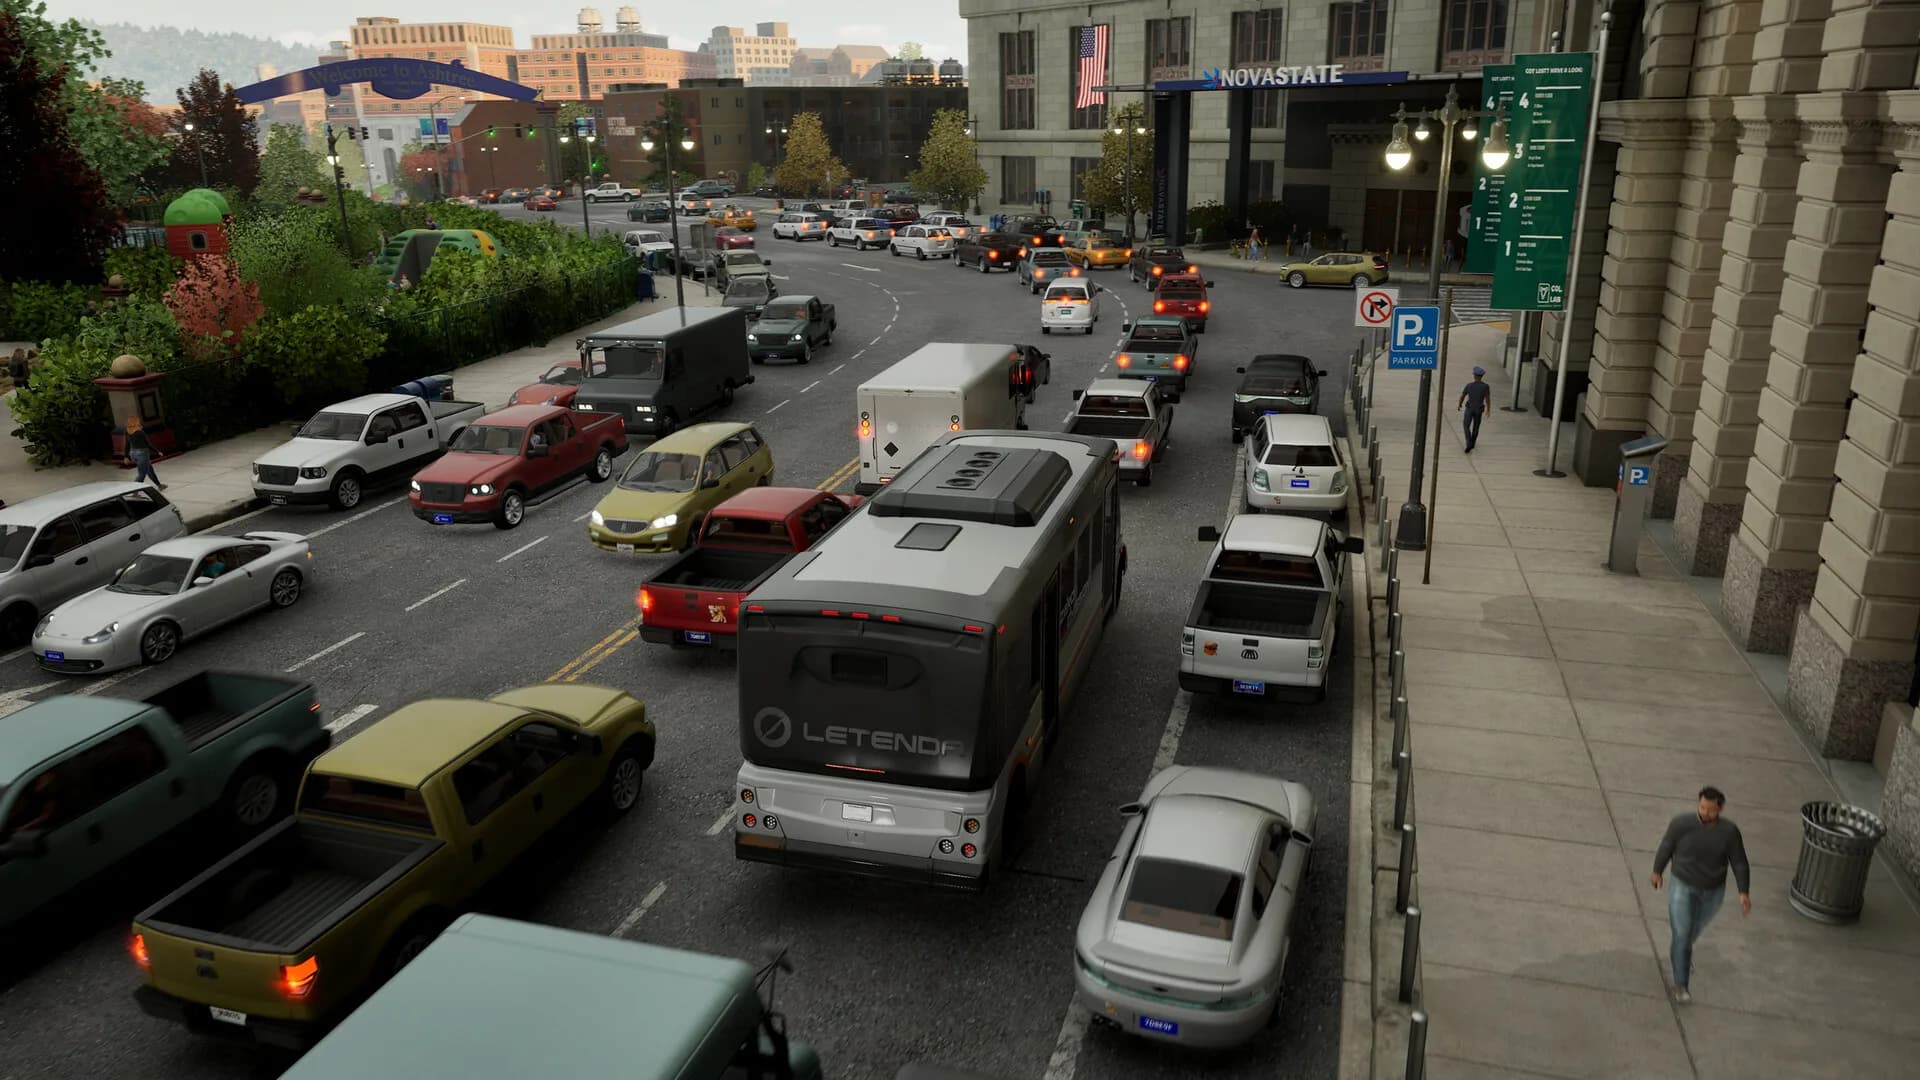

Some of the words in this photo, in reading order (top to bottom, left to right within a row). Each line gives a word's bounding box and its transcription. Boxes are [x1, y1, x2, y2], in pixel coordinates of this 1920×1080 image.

[308, 64, 386, 84] Welcome
[393, 62, 409, 77] to
[416, 63, 476, 87] Ashtree
[1221, 64, 1344, 87] NOVASTATE
[1486, 95, 1495, 110] 4
[1519, 92, 1529, 109] 4
[1514, 143, 1523, 159] 3
[1479, 177, 1487, 190] 2
[1509, 192, 1518, 208] 2
[1476, 217, 1481, 230] 1
[1505, 241, 1511, 256] 1
[1396, 314, 1423, 346] P
[1415, 336, 1433, 346] 24h
[1630, 468, 1644, 484] P
